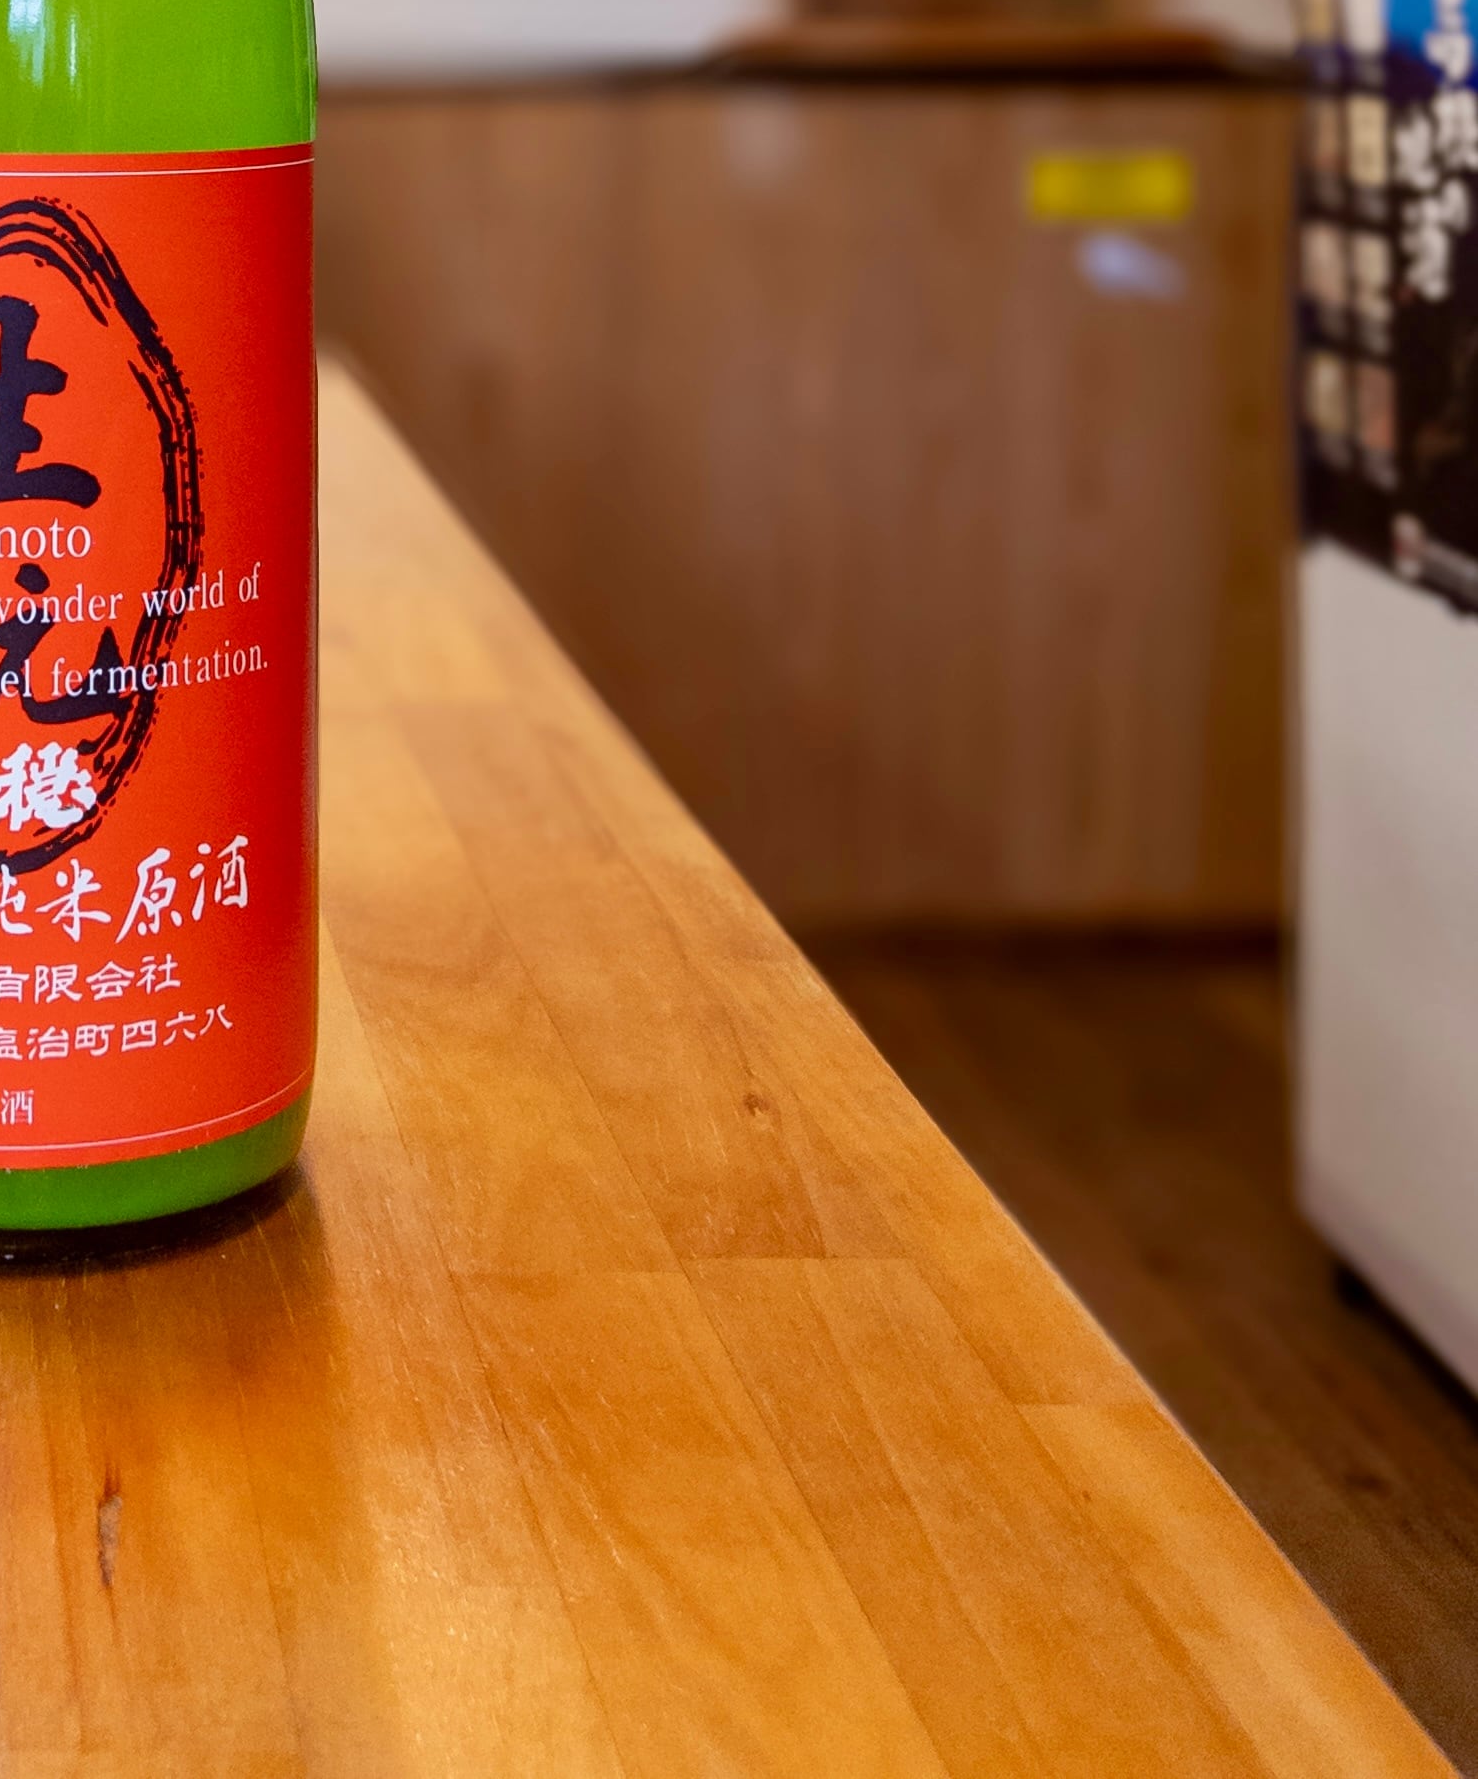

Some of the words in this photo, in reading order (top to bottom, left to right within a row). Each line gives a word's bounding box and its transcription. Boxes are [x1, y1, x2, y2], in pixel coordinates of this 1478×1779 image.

[142, 570, 225, 617] world
[238, 562, 261, 601] of
[50, 640, 269, 697] fermentation.
